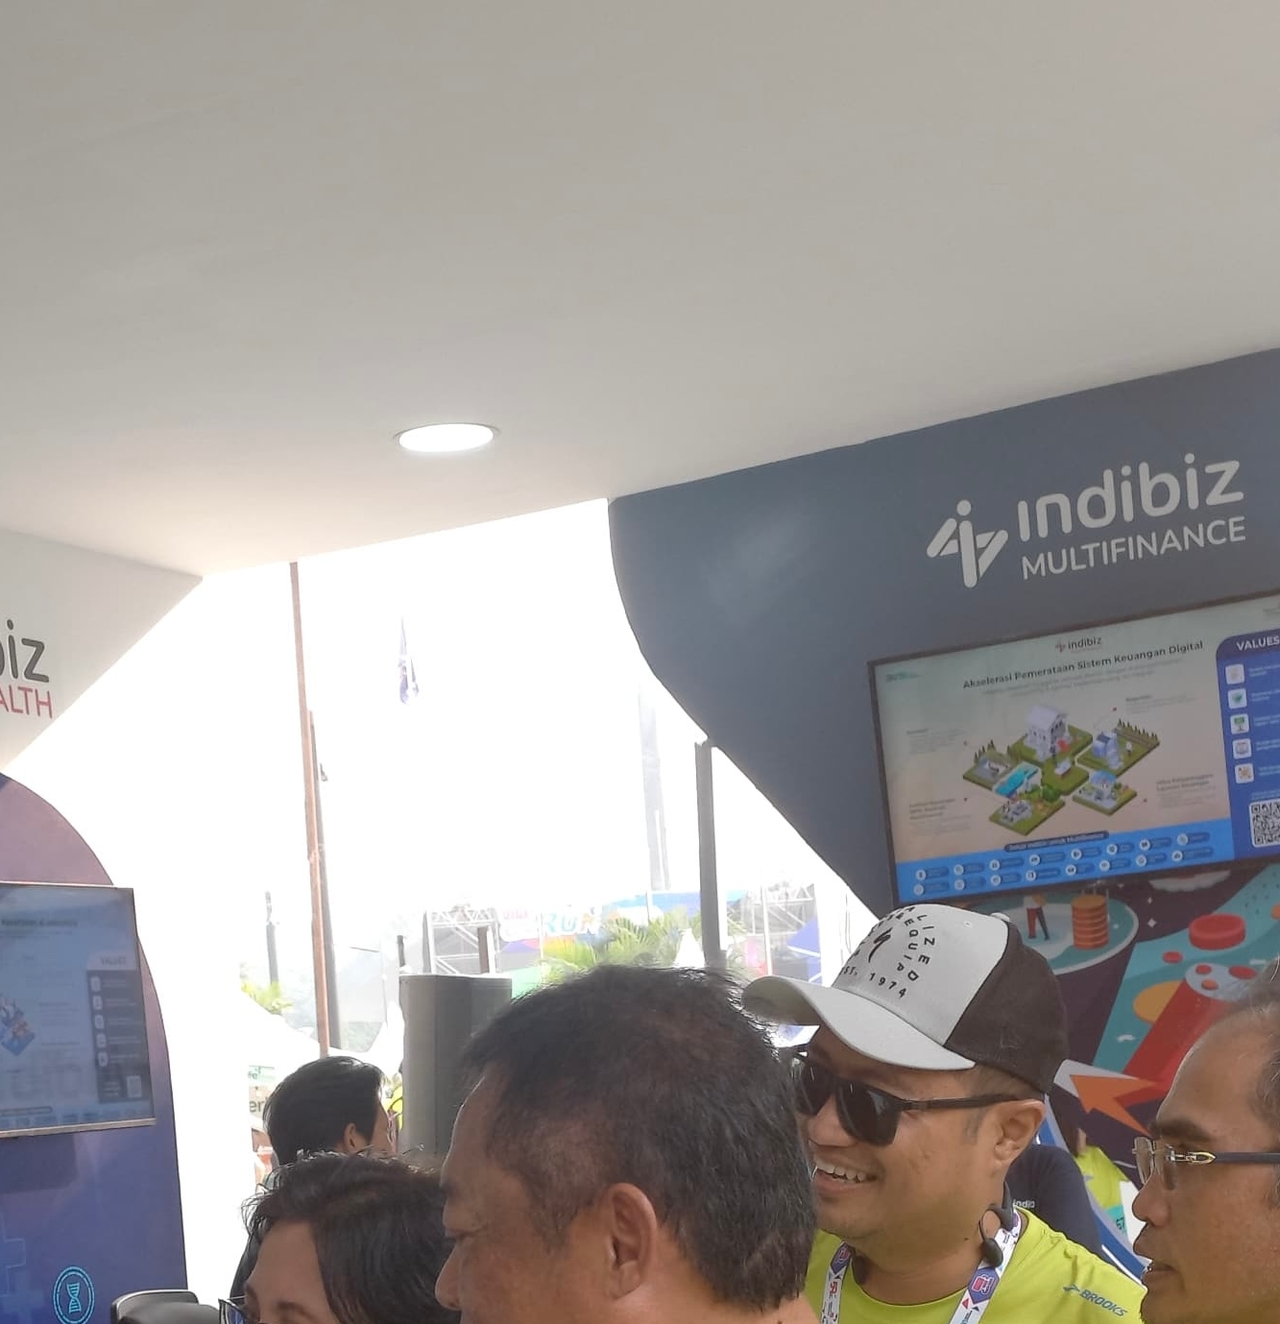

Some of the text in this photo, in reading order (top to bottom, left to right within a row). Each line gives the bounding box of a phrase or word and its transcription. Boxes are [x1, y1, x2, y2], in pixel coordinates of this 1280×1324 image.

[1018, 453, 1245, 542] indibiz
[1022, 516, 1247, 580] MULTIFINANCE
[1067, 636, 1102, 651] indibiz
[1236, 635, 1280, 652] VALUES
[963, 640, 1204, 690] Akselerasi Pemerataan Sistem Keuangan Digital
[868, 972, 907, 998] 1974
[1079, 1288, 1128, 1317] BROOKS
